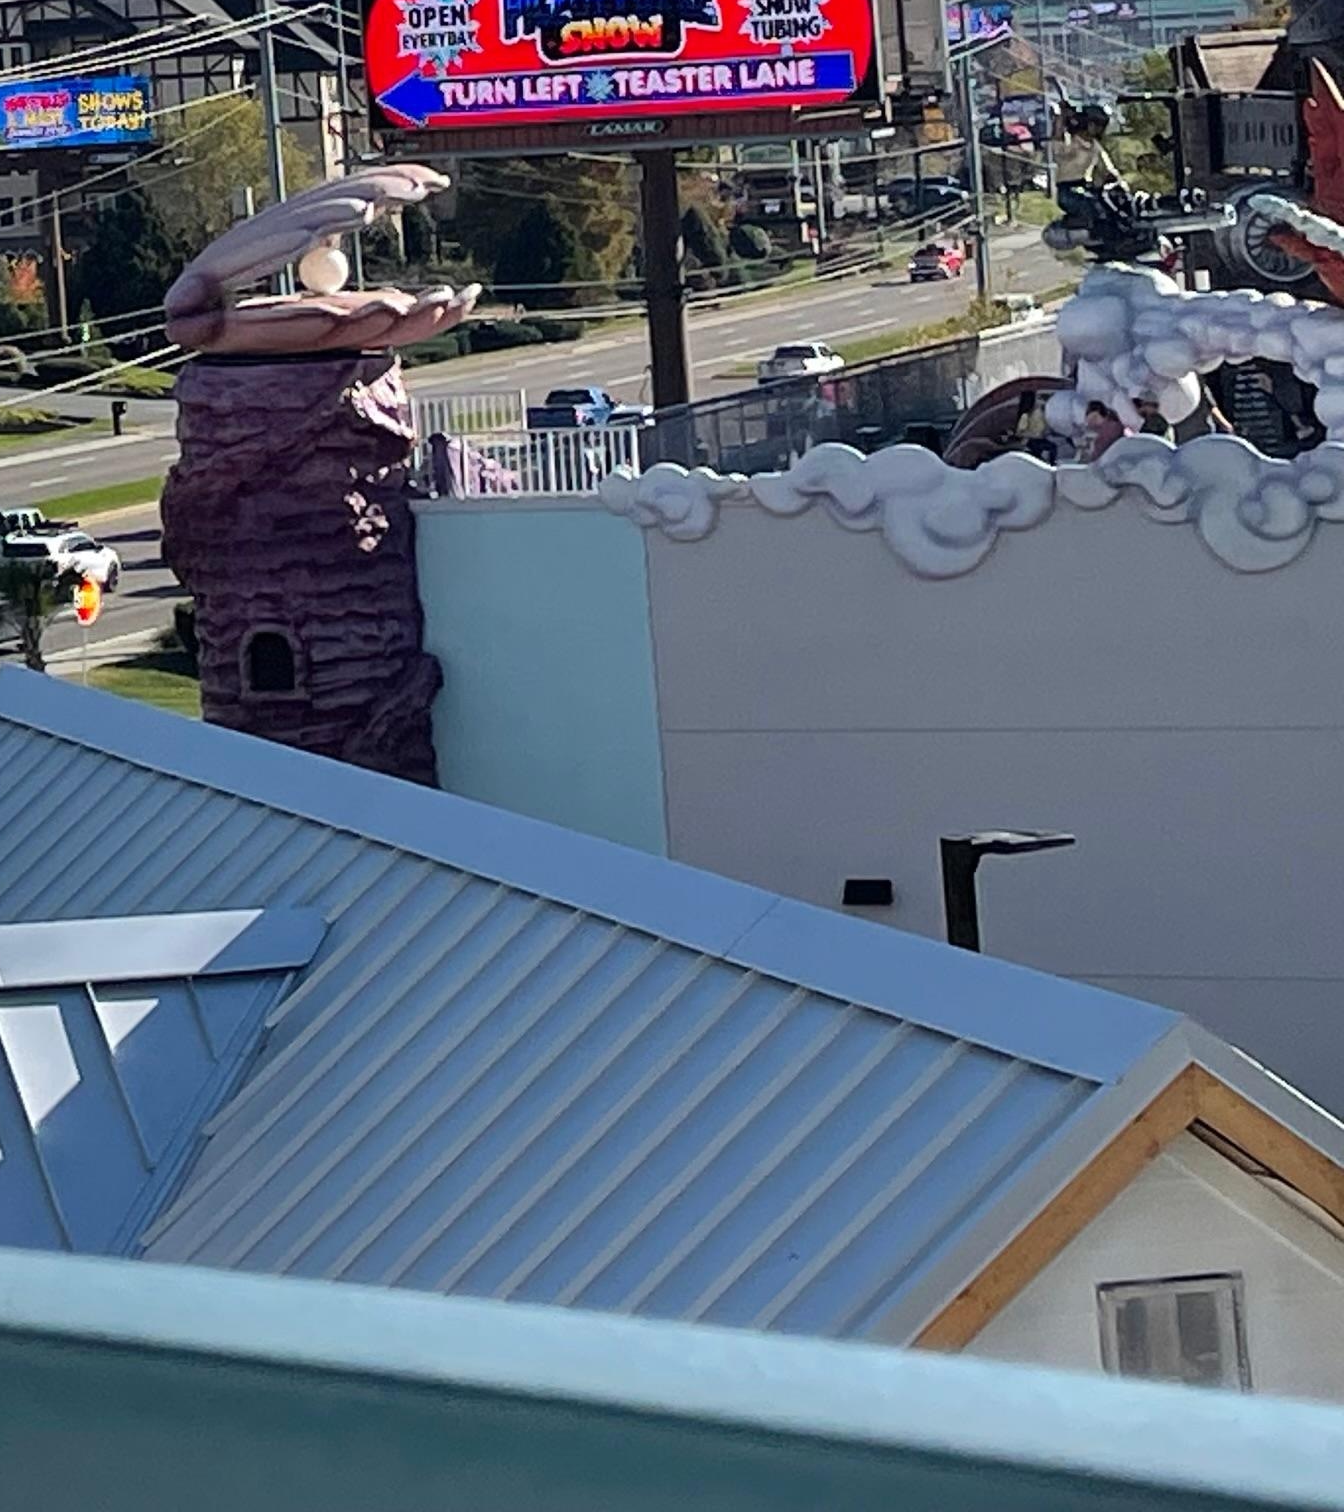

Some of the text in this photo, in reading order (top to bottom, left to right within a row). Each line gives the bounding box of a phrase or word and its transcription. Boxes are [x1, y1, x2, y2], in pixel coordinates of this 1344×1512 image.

[408, 3, 467, 29] OPEN
[751, 16, 822, 39] TUBING
[402, 31, 476, 50] EVERYDAY
[560, 14, 664, 54] SNOW
[439, 59, 815, 107] TURN LEFT TEASTER LANE
[78, 90, 144, 113] SHOWS
